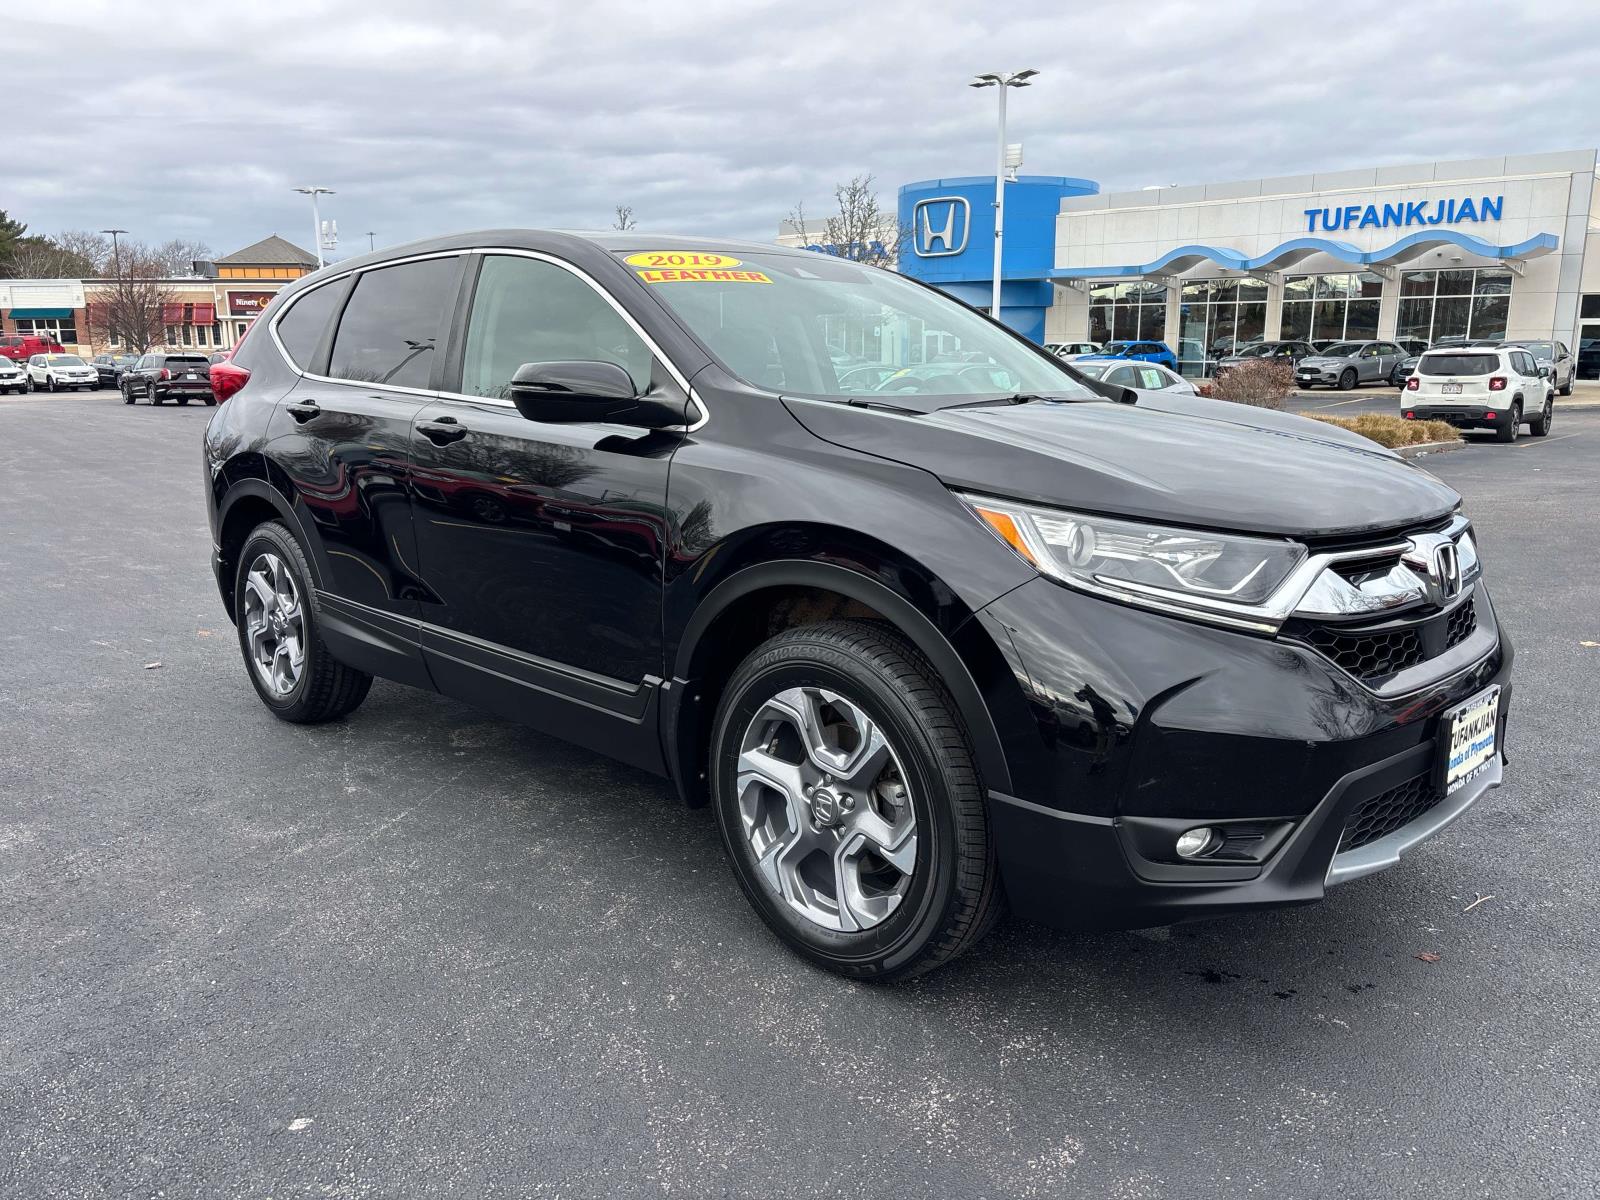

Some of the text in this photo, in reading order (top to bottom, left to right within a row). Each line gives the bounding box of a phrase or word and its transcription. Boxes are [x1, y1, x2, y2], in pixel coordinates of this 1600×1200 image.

[1304, 196, 1503, 232] TUFANKJIAN
[648, 255, 722, 266] 2019
[644, 271, 767, 282] LEATHER
[1449, 751, 1463, 769] onda
